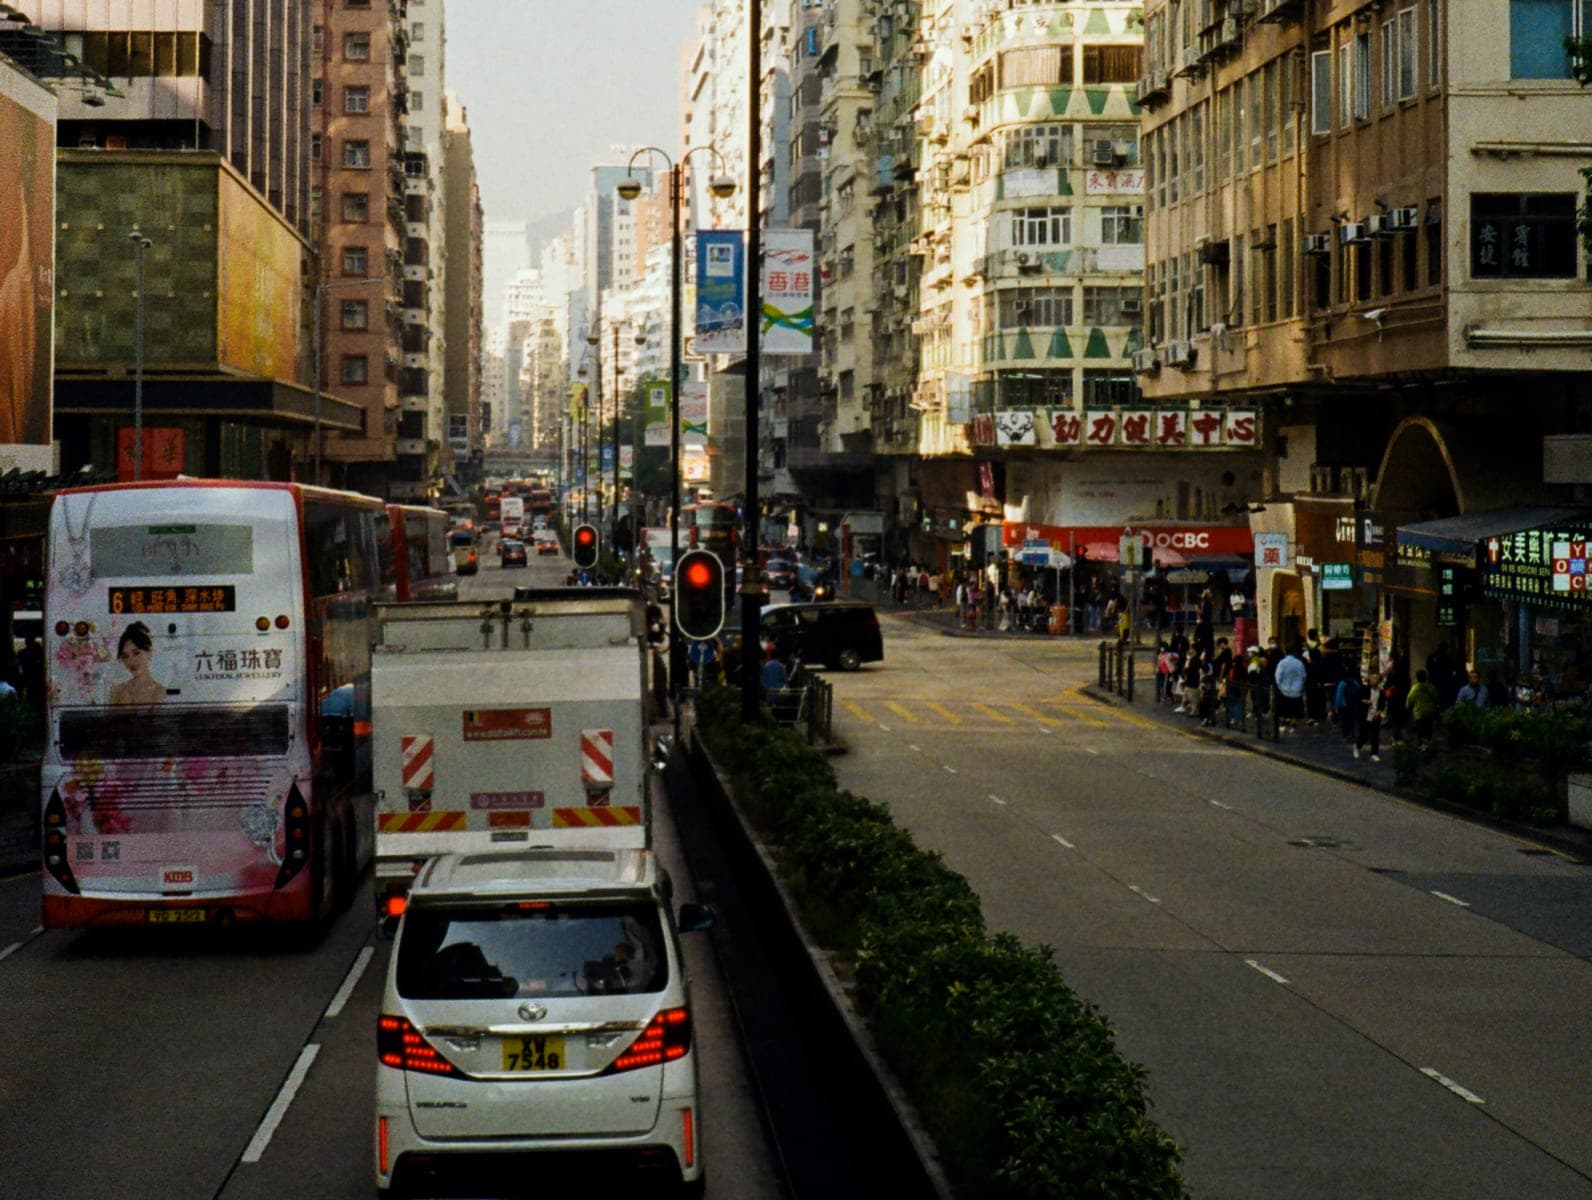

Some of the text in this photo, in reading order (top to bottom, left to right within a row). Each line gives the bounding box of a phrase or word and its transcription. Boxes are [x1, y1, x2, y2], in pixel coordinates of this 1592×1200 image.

[769, 272, 809, 291] 香港
[1052, 413, 1255, 444] 動力健美中心
[1156, 532, 1209, 548] OCBC
[1264, 548, 1280, 564] 藥
[113, 591, 123, 613] 6
[194, 648, 283, 672] 六福珠寶
[164, 870, 193, 883] KMB
[508, 1053, 559, 1071] 7548
